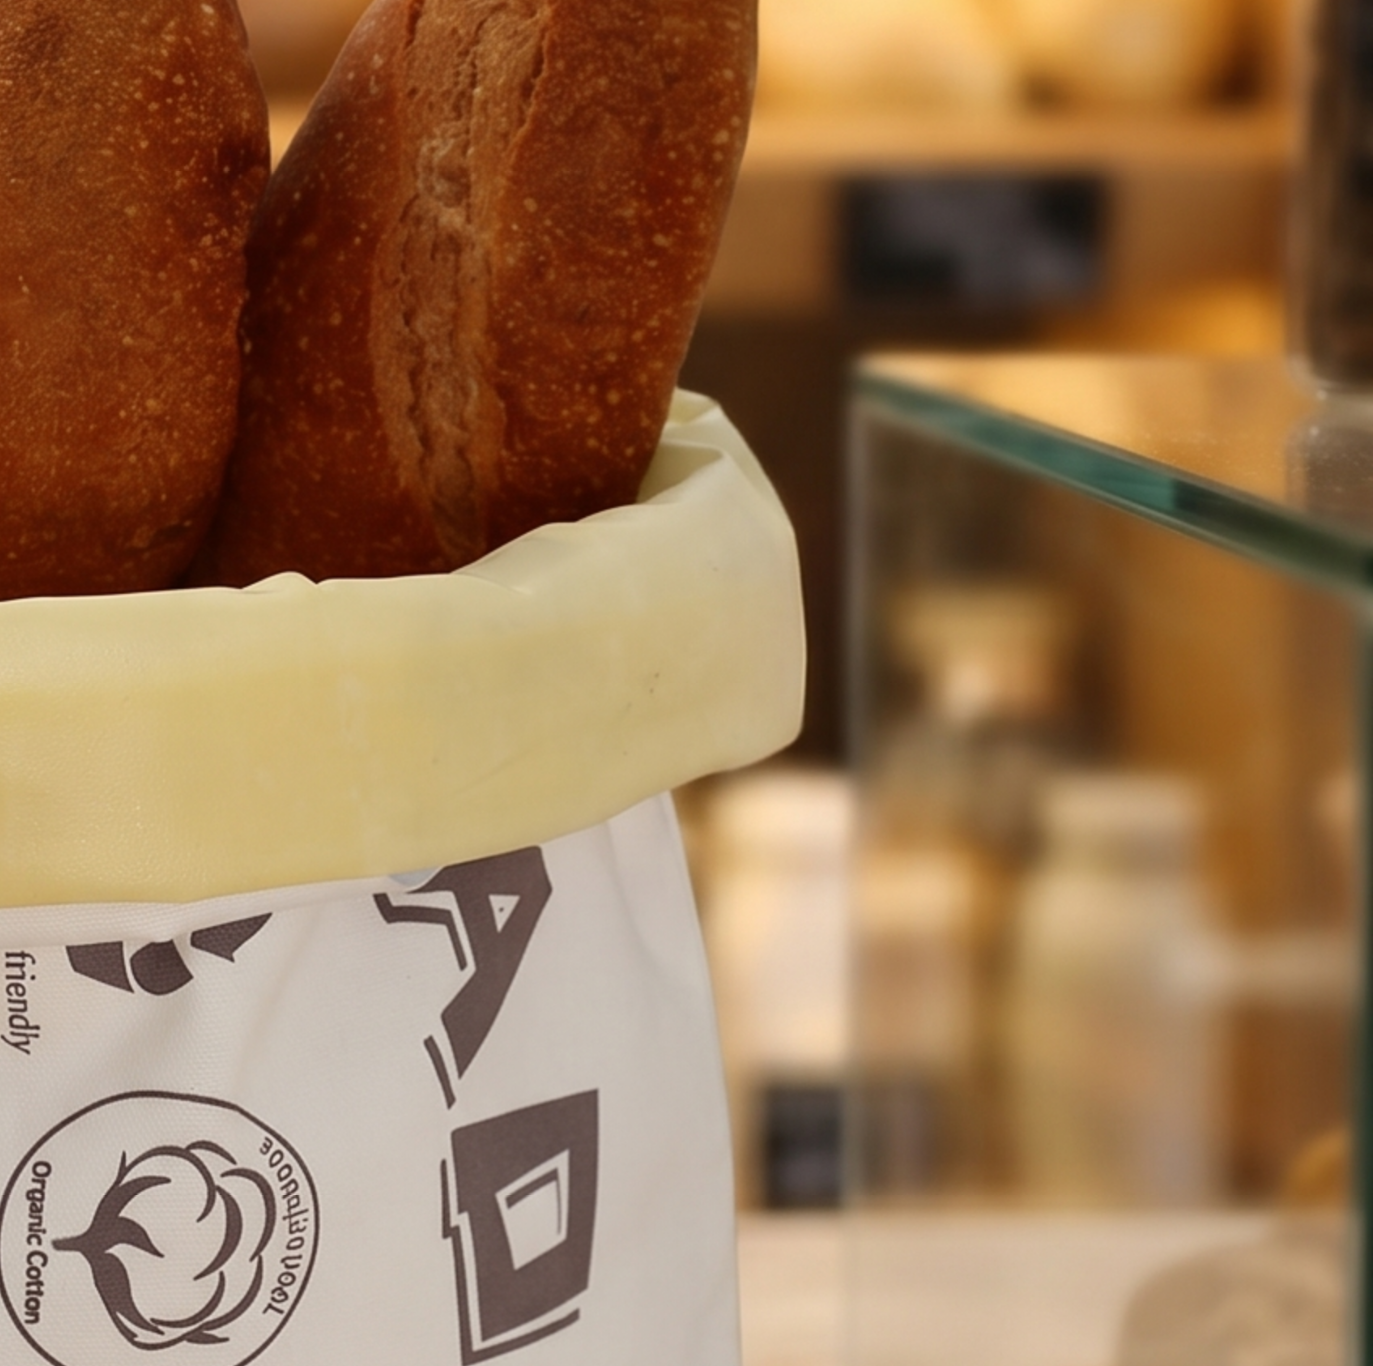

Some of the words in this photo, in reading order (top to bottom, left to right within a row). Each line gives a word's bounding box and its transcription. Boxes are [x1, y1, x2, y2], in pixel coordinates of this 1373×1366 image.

[0, 950, 41, 1055] friendly
[26, 1160, 53, 1246] Organic
[25, 1250, 48, 1325] Cotton
